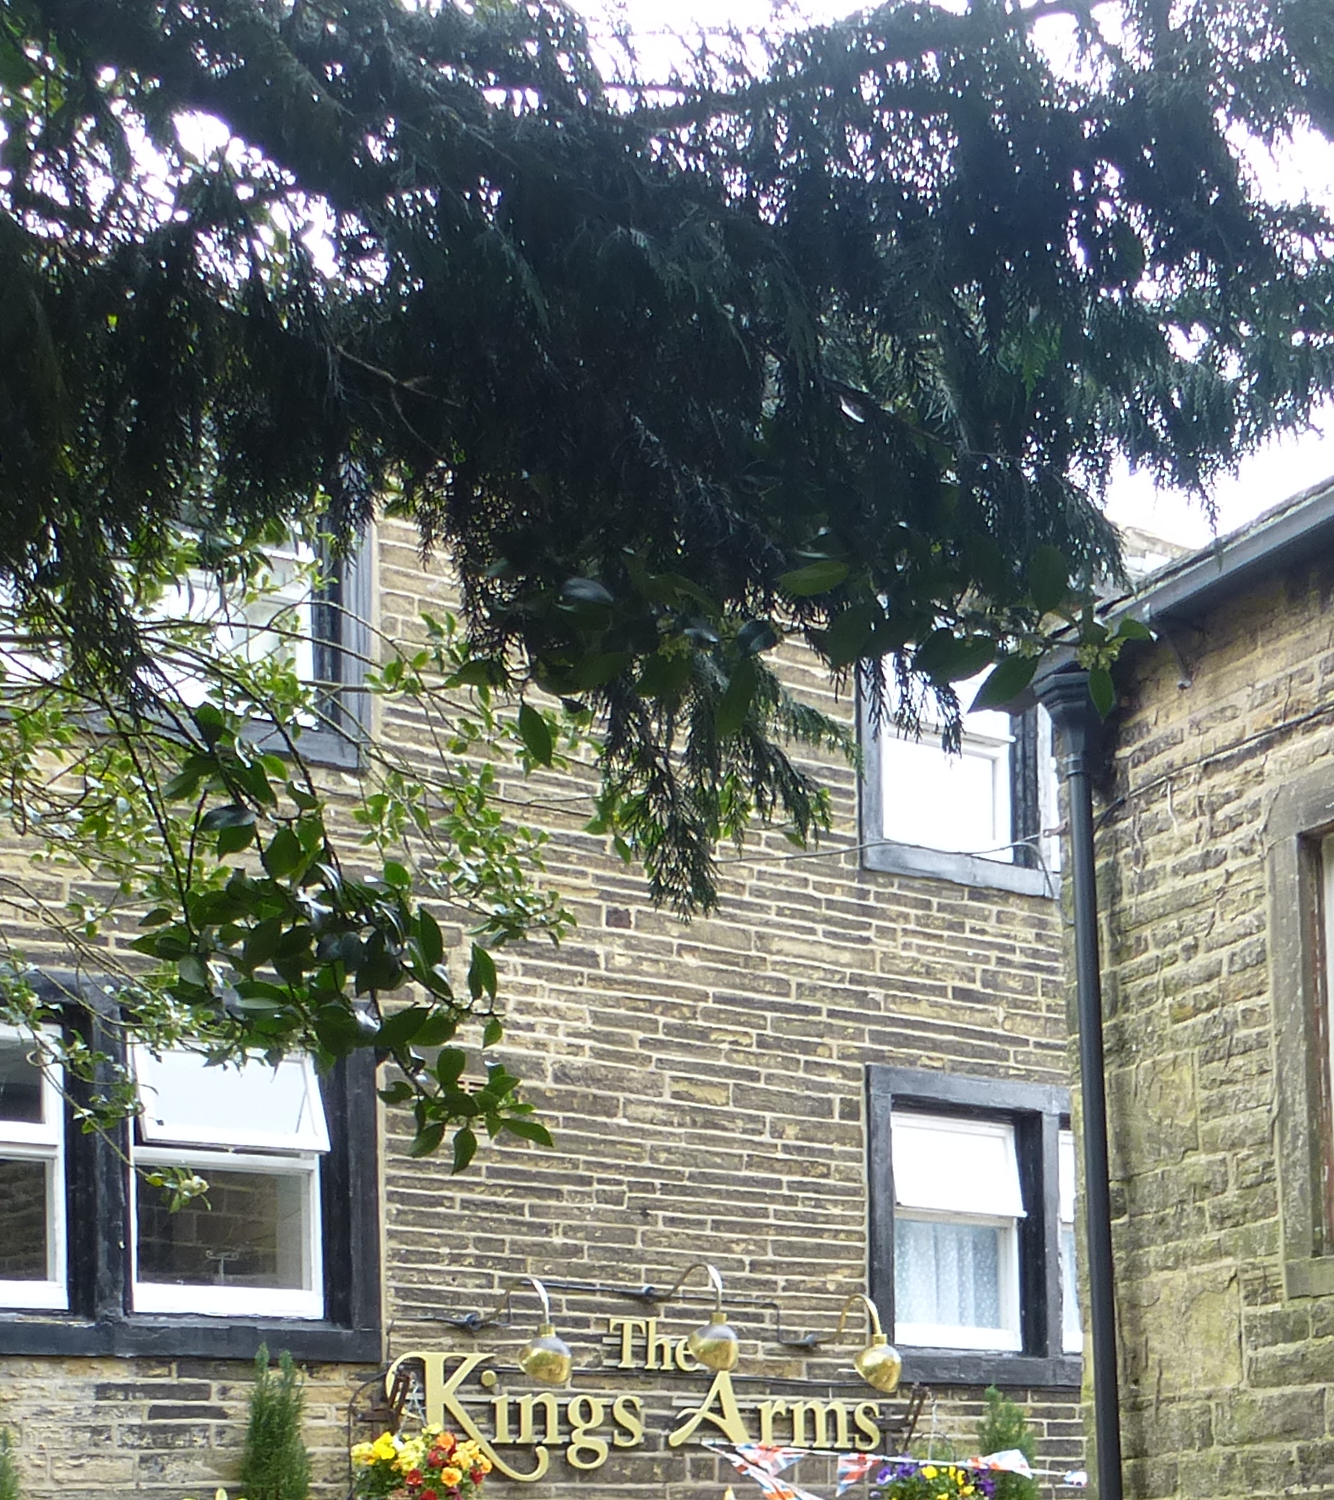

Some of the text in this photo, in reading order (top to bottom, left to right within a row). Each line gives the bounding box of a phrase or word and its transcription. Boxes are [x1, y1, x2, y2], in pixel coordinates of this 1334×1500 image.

[609, 1317, 701, 1372] The
[385, 1351, 881, 1482] Kings Arms
